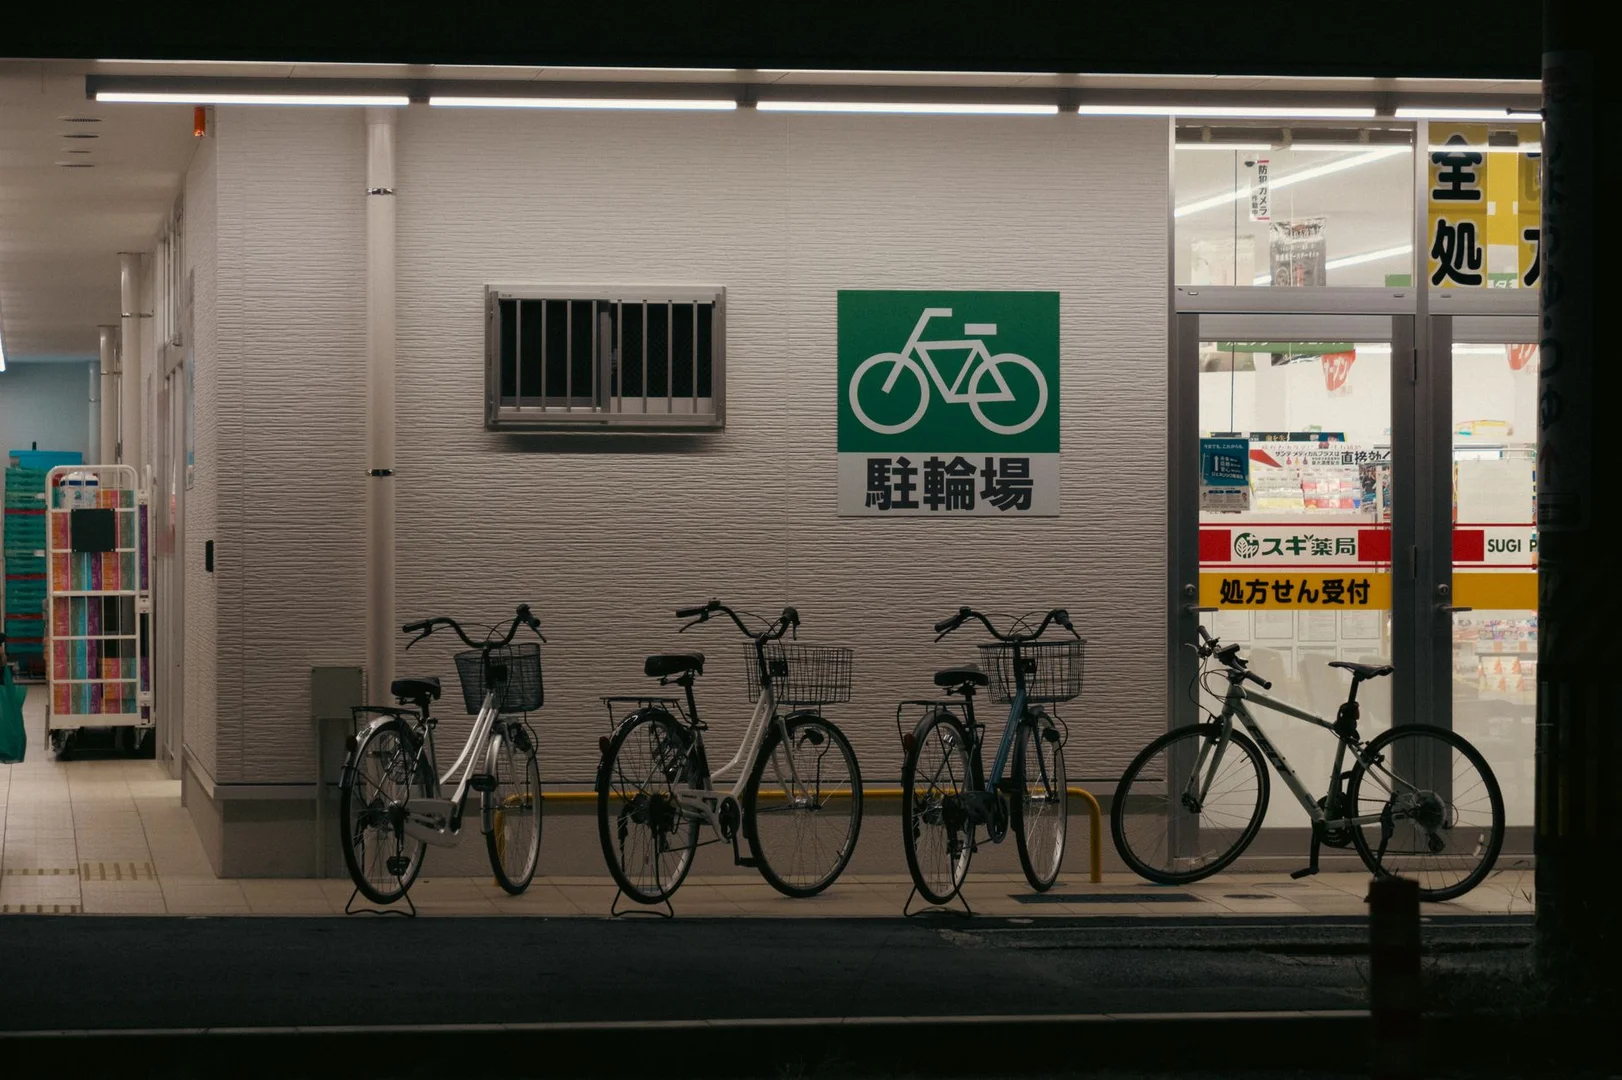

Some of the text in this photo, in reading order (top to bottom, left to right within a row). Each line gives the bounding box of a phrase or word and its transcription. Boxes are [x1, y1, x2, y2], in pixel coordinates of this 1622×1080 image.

[1258, 164, 1268, 216] 防犯カメラ
[865, 456, 1034, 511] 駐輪場
[1262, 534, 1356, 557] スギ薬局
[1487, 539, 1521, 553] SUGI
[1220, 578, 1371, 605] 処方せん受付
